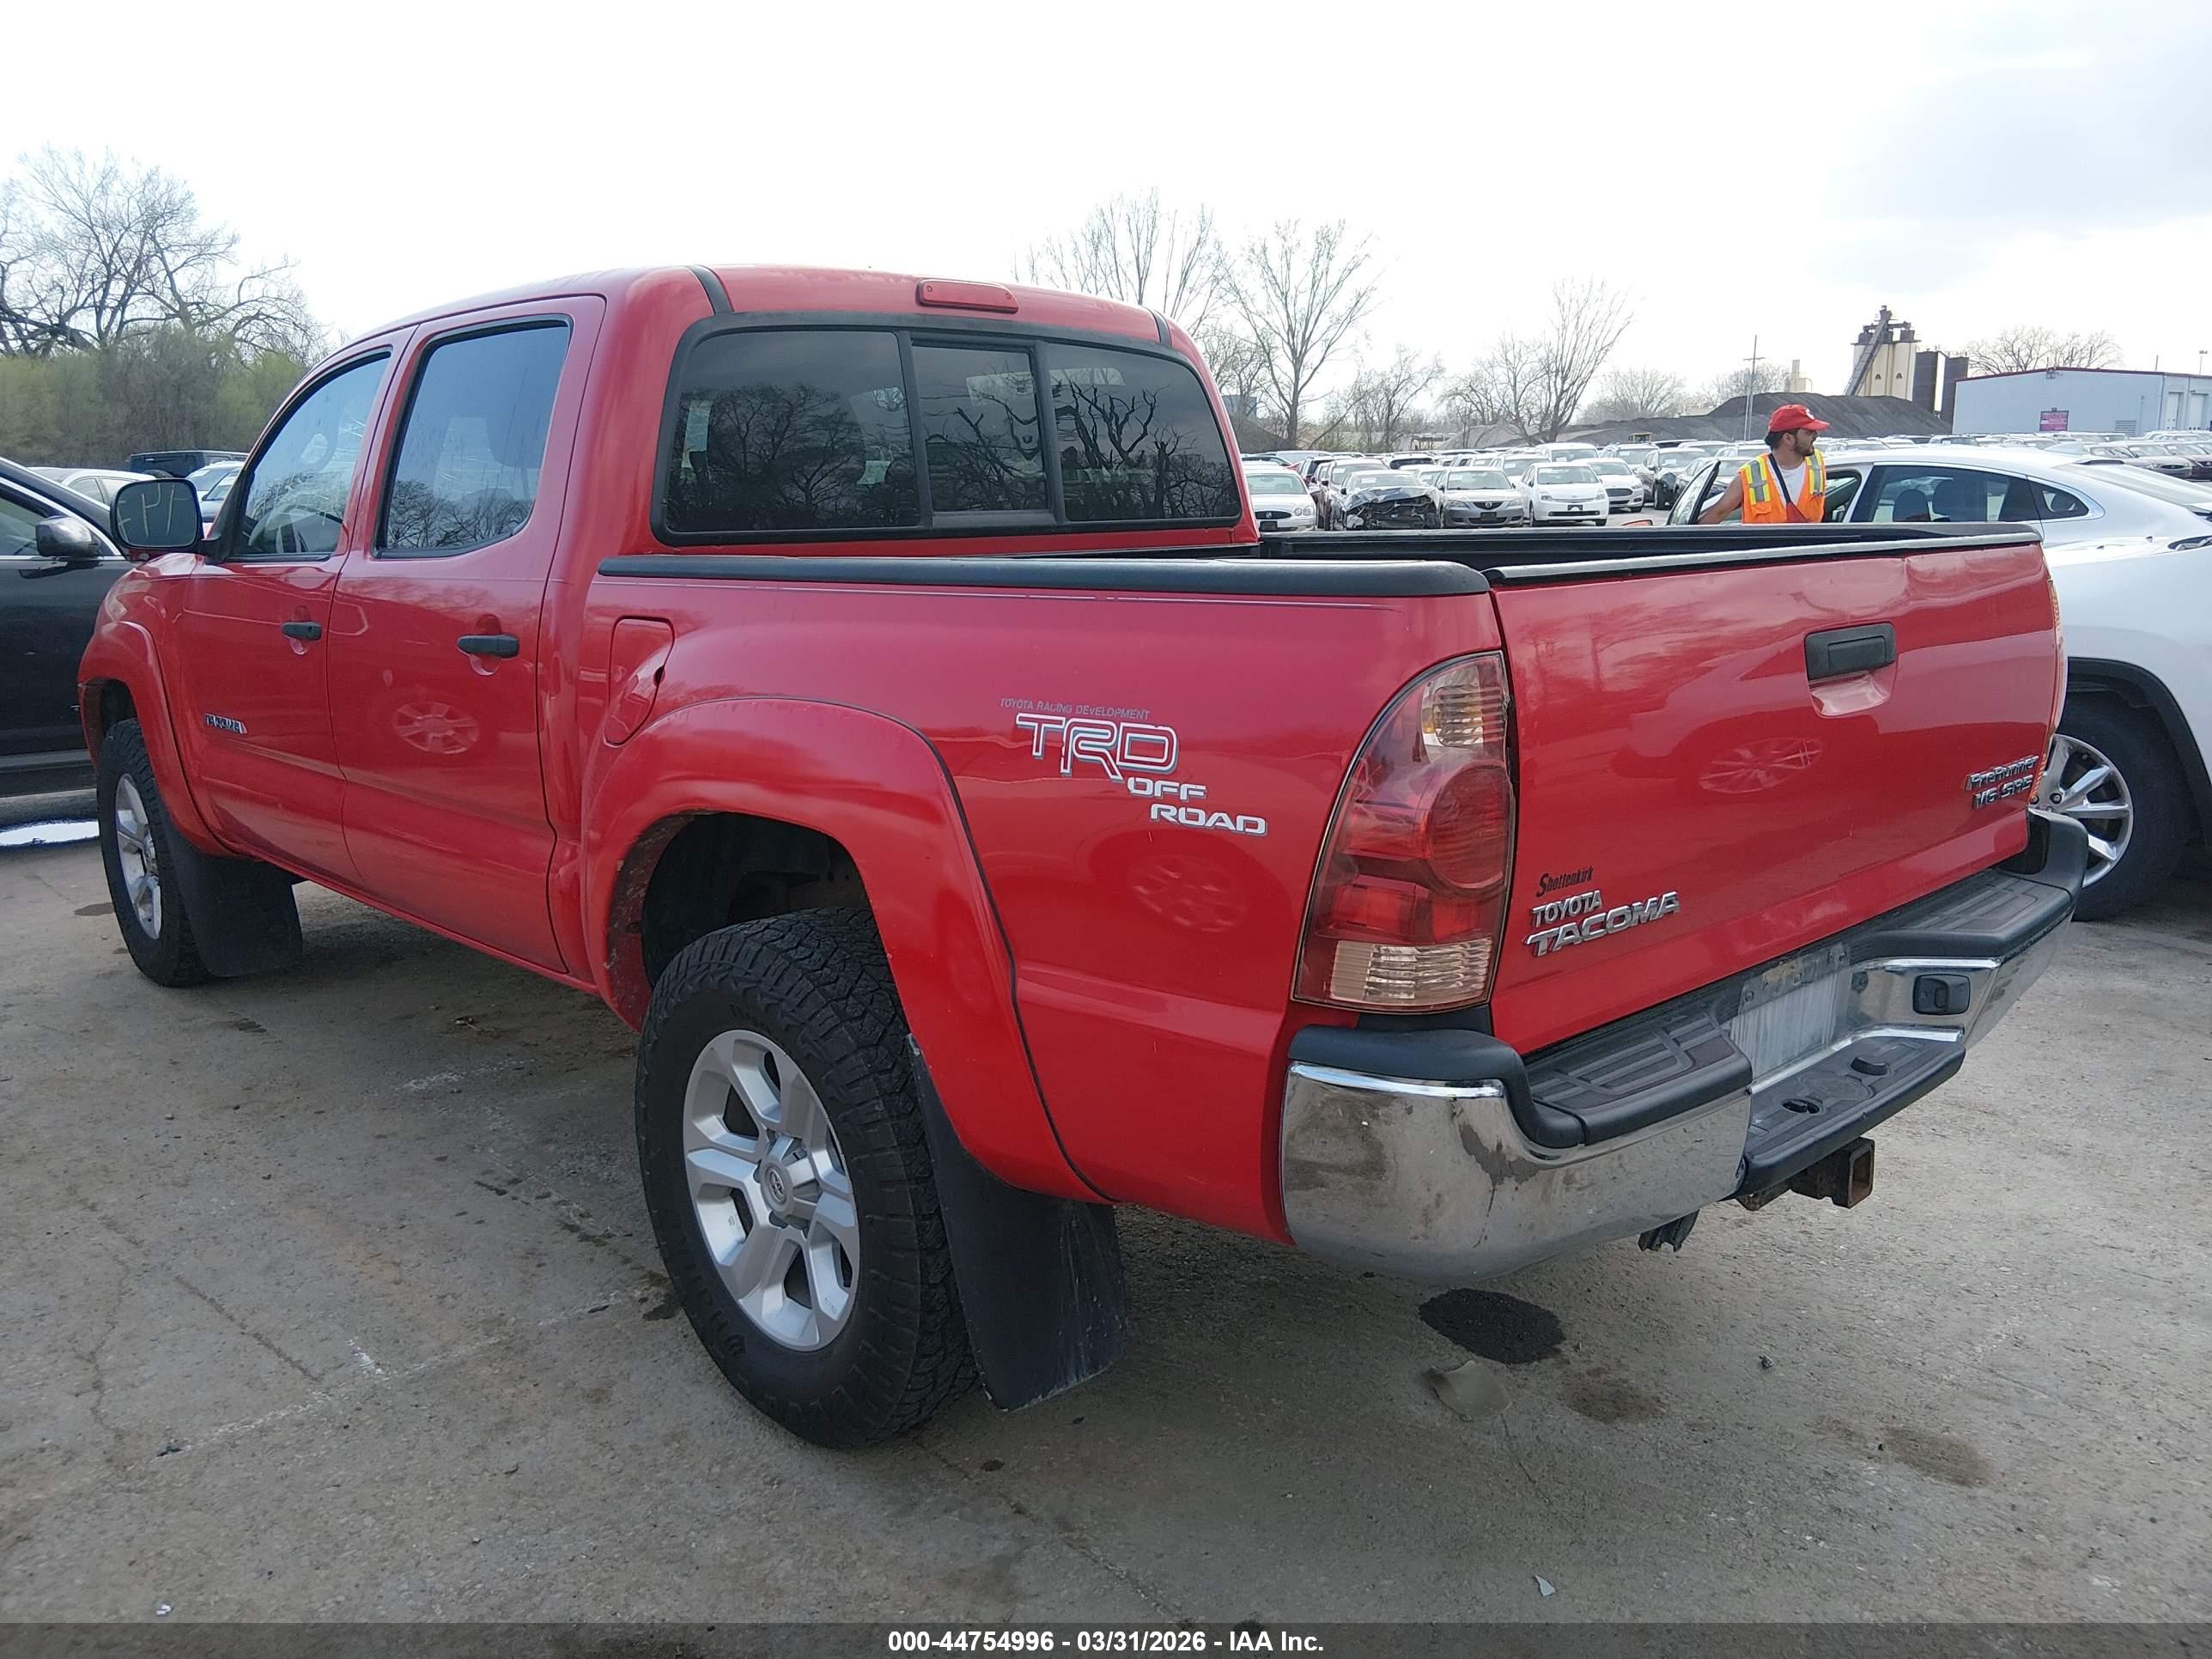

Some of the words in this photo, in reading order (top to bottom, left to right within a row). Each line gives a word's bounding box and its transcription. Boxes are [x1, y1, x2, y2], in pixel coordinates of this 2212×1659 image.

[204, 714, 247, 734] TACOMA
[1000, 698, 1034, 710] TOYOTA
[1036, 701, 1073, 714] RACING
[1076, 705, 1151, 720] DEVELOPMENT
[1016, 713, 1178, 783] TRD
[1127, 776, 1207, 802] OFF
[1151, 804, 1267, 836] ROAD
[1526, 890, 1680, 957] TACOMA
[1532, 890, 1603, 927] TOYOTA
